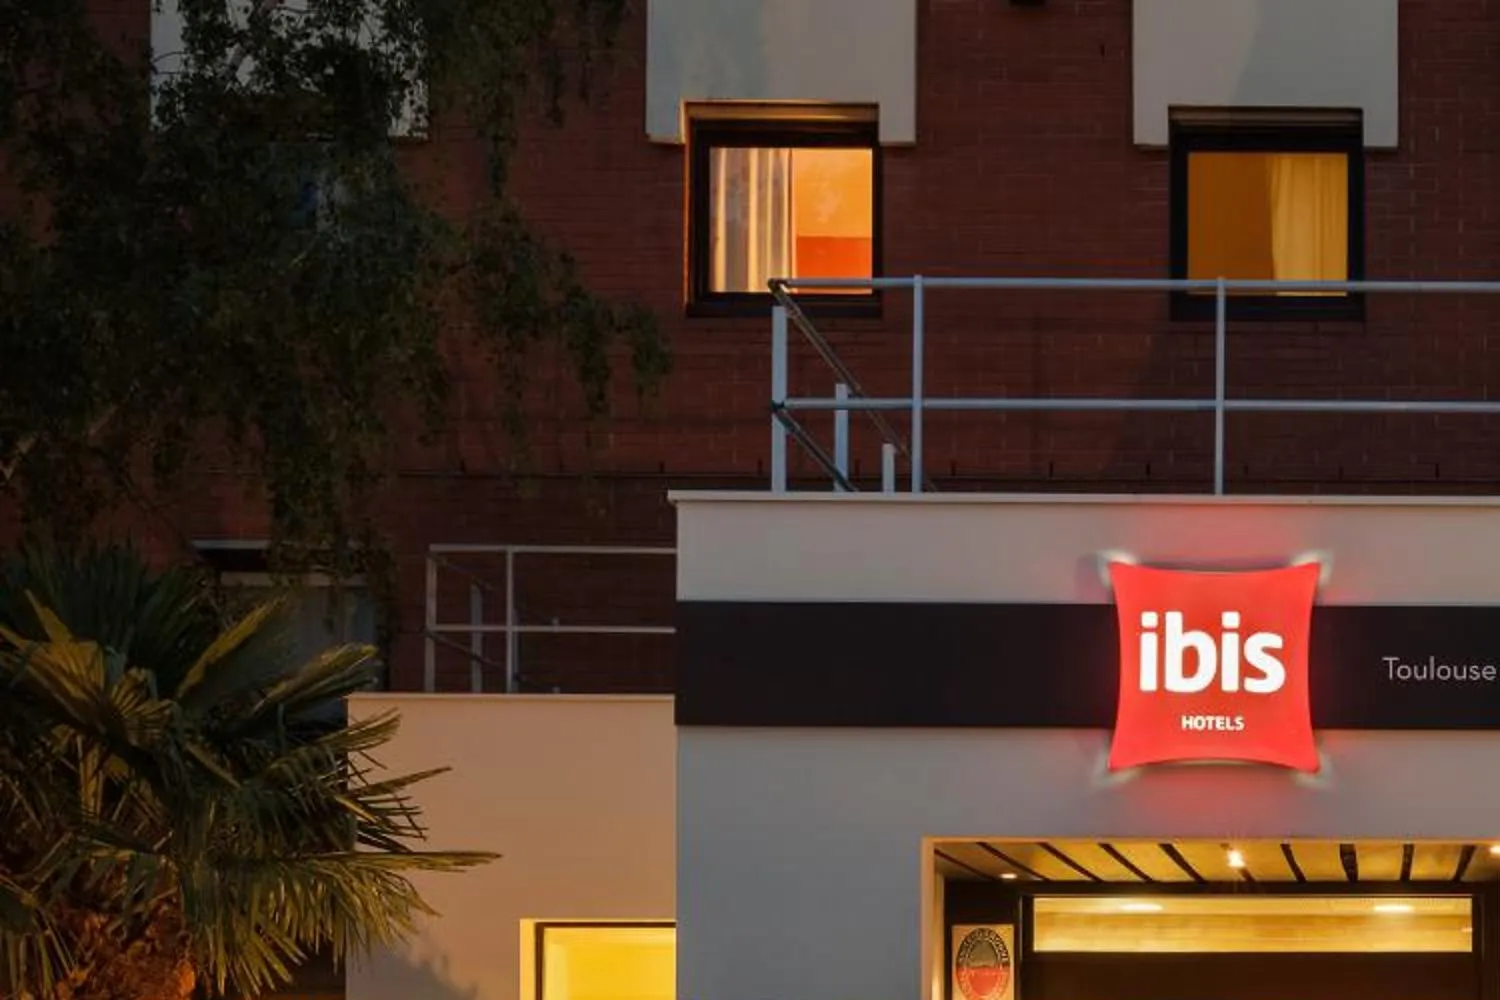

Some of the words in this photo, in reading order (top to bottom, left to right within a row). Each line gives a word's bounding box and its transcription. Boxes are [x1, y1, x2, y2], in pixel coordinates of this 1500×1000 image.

[1139, 611, 1286, 694] ibis
[1382, 656, 1497, 681] Toulouse
[1181, 715, 1245, 731] HOTELS
